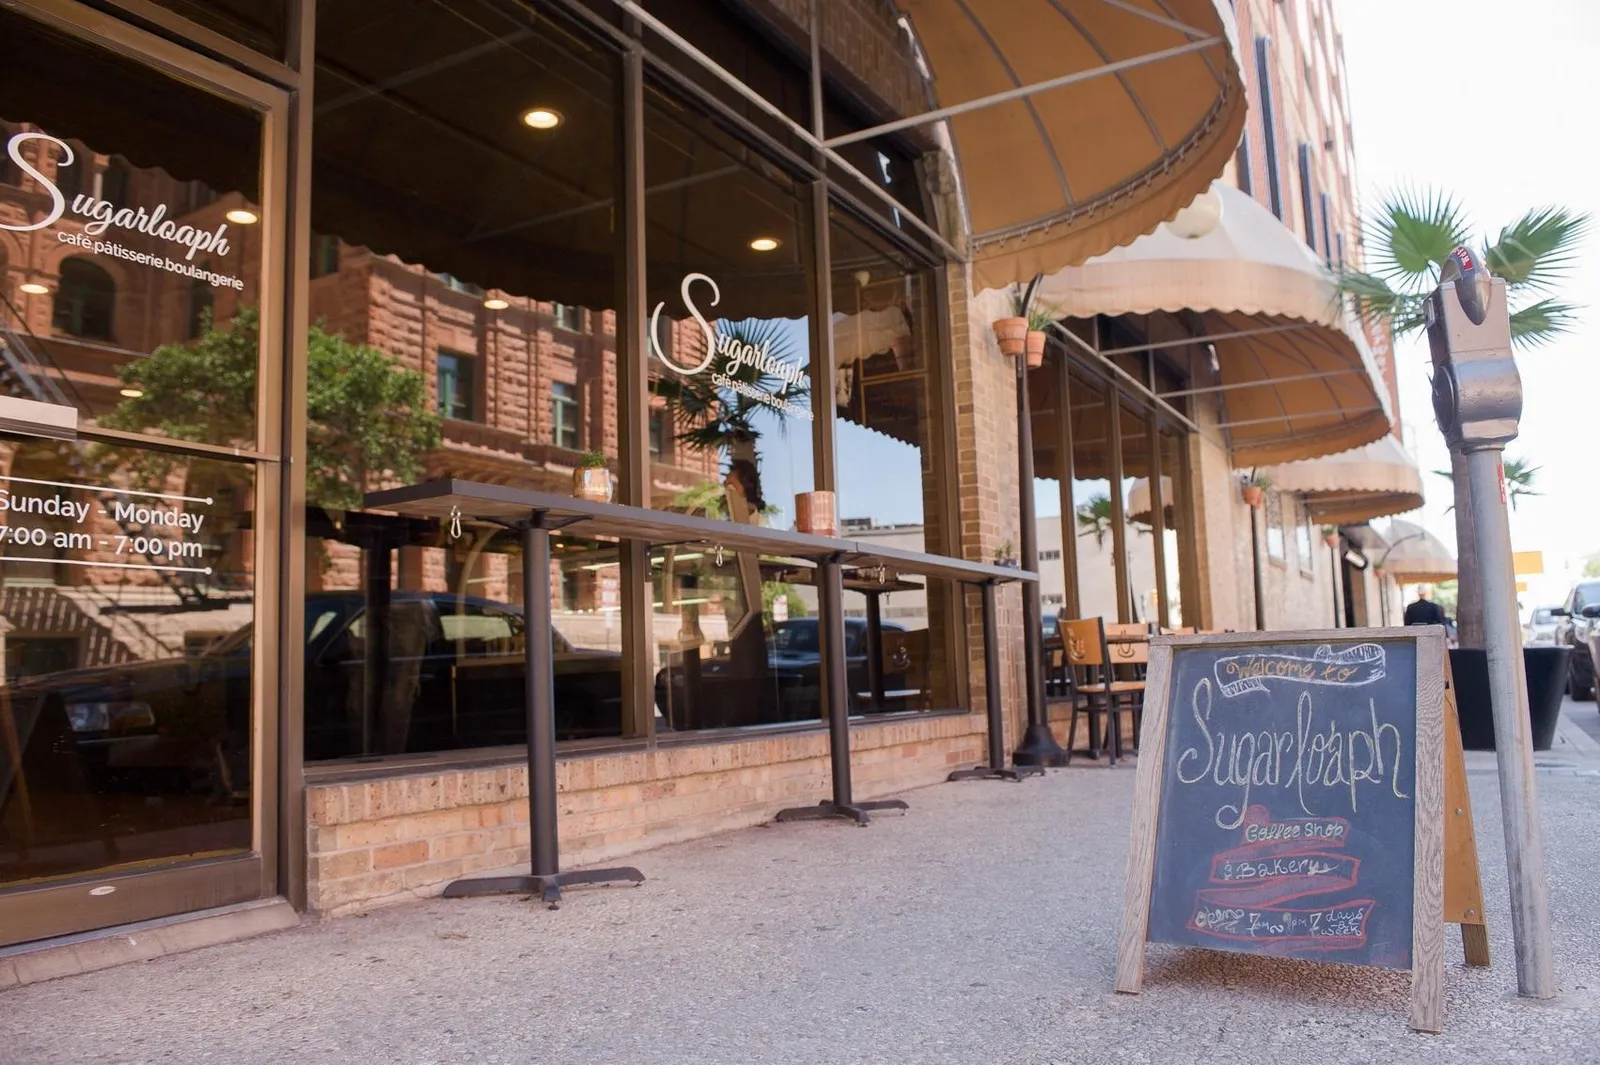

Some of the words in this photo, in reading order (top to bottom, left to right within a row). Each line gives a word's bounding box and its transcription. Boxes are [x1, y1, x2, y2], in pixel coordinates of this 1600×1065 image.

[0, 132, 230, 260] Sugarloaph
[651, 272, 806, 395] Sugarloaph
[0, 489, 90, 523] Sunday
[115, 501, 204, 533] Monday
[0, 525, 47, 547] 7:00
[53, 532, 92, 550] am
[114, 535, 163, 555] 7:00
[168, 541, 203, 560] pm
[1226, 658, 1316, 681] Welcome
[1320, 662, 1359, 681] to
[1177, 677, 1410, 830] Sugarloaph
[1245, 823, 1300, 843] Coffee
[1236, 859, 1339, 879] Bakery
